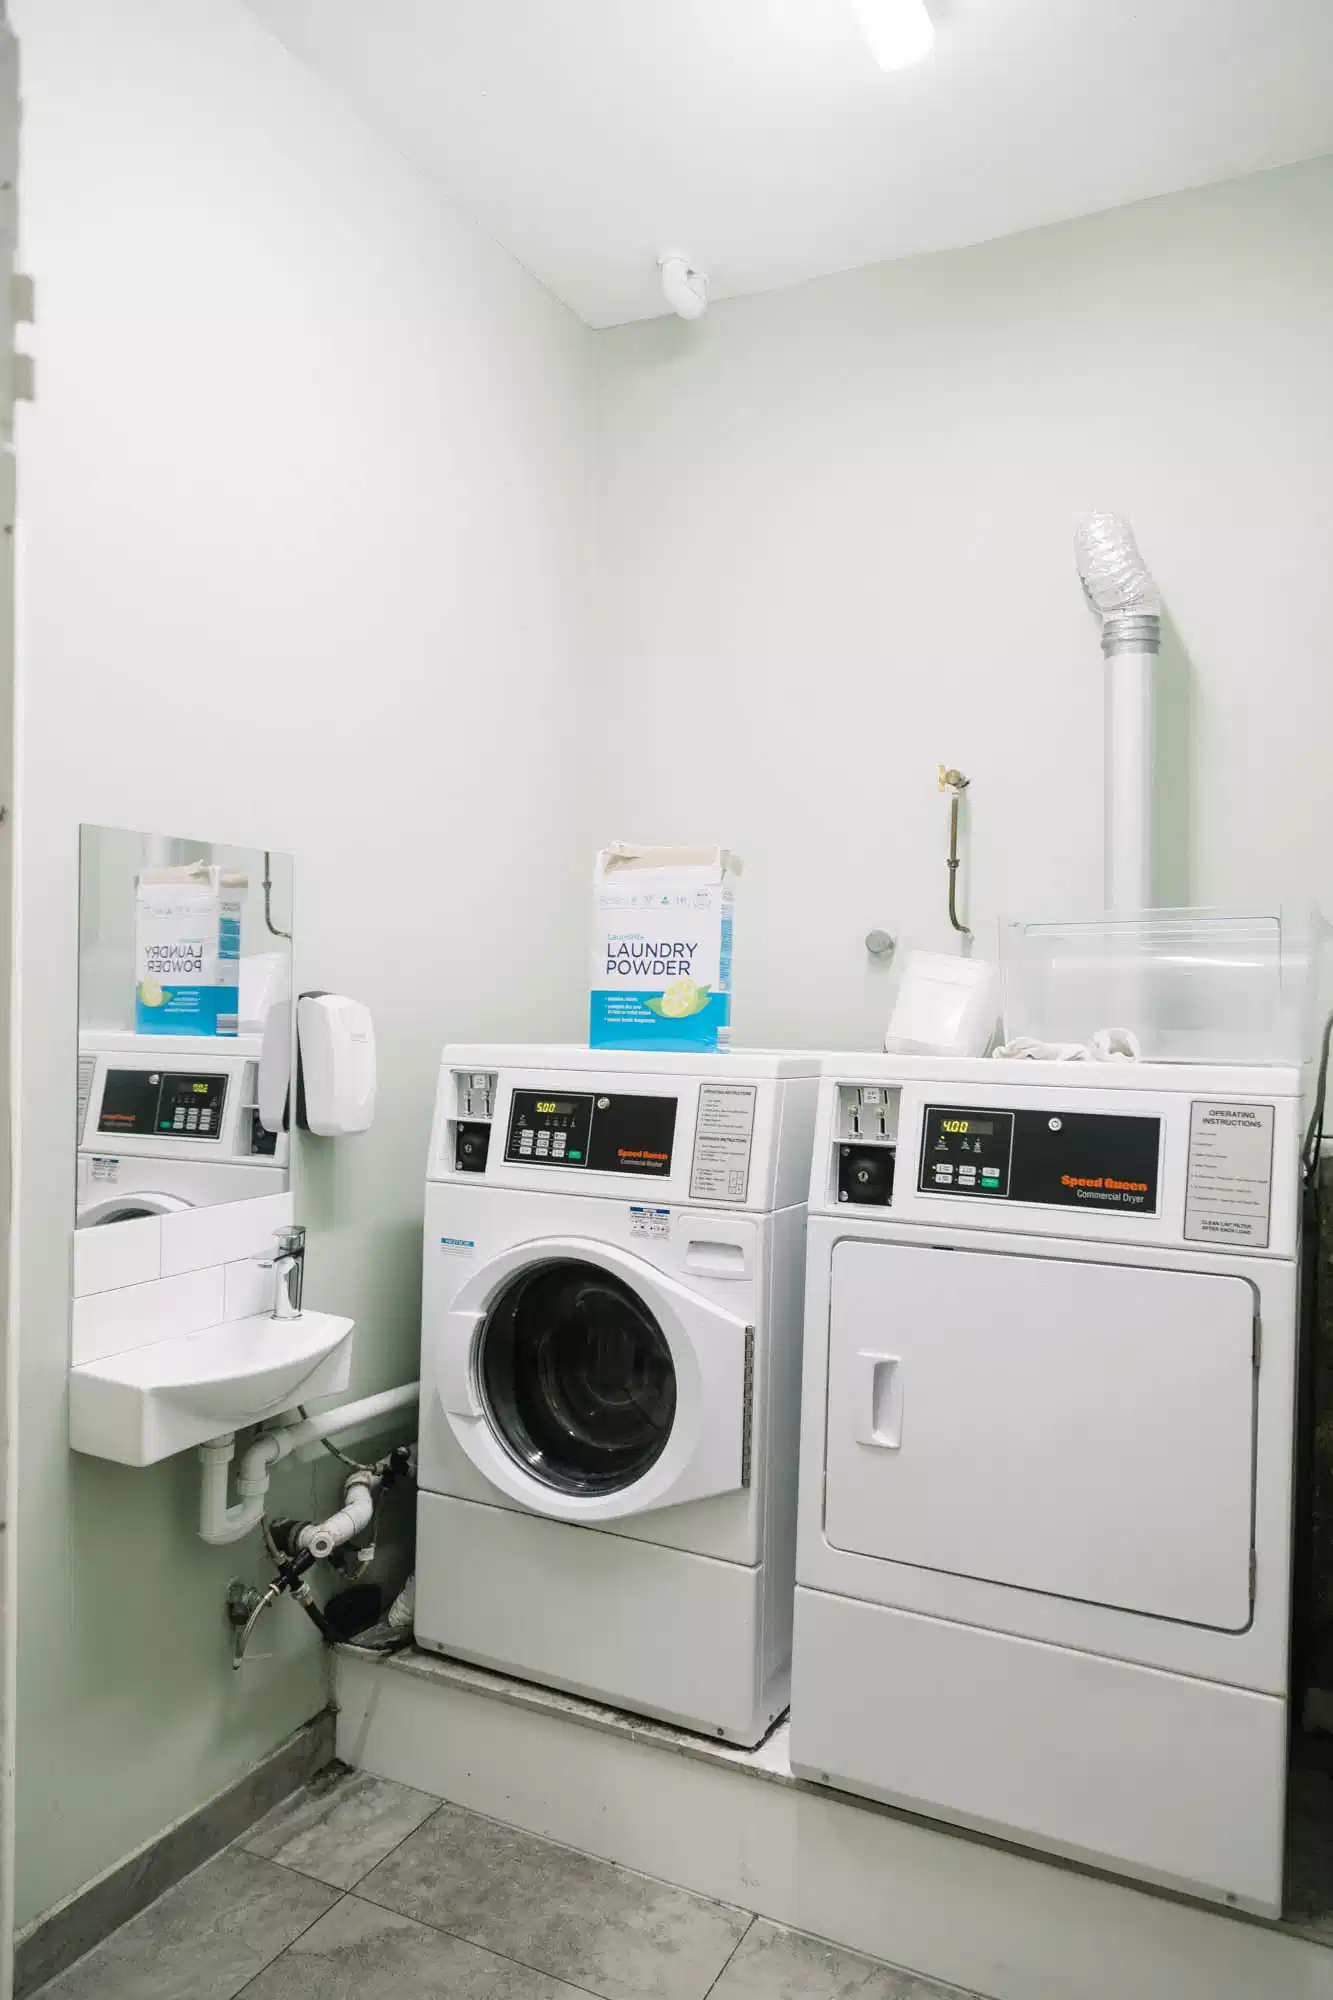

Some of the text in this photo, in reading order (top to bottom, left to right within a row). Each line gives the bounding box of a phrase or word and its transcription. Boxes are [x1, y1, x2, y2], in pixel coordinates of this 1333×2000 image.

[607, 943, 698, 958] LAUNDRY
[606, 960, 691, 975] POWDER
[1208, 1109, 1256, 1119] OPERATING
[1202, 1118, 1262, 1128] INSTRUCTIONS
[1061, 1175, 1148, 1192] Speed Queen
[1077, 1189, 1145, 1204] Commercial Dryer
